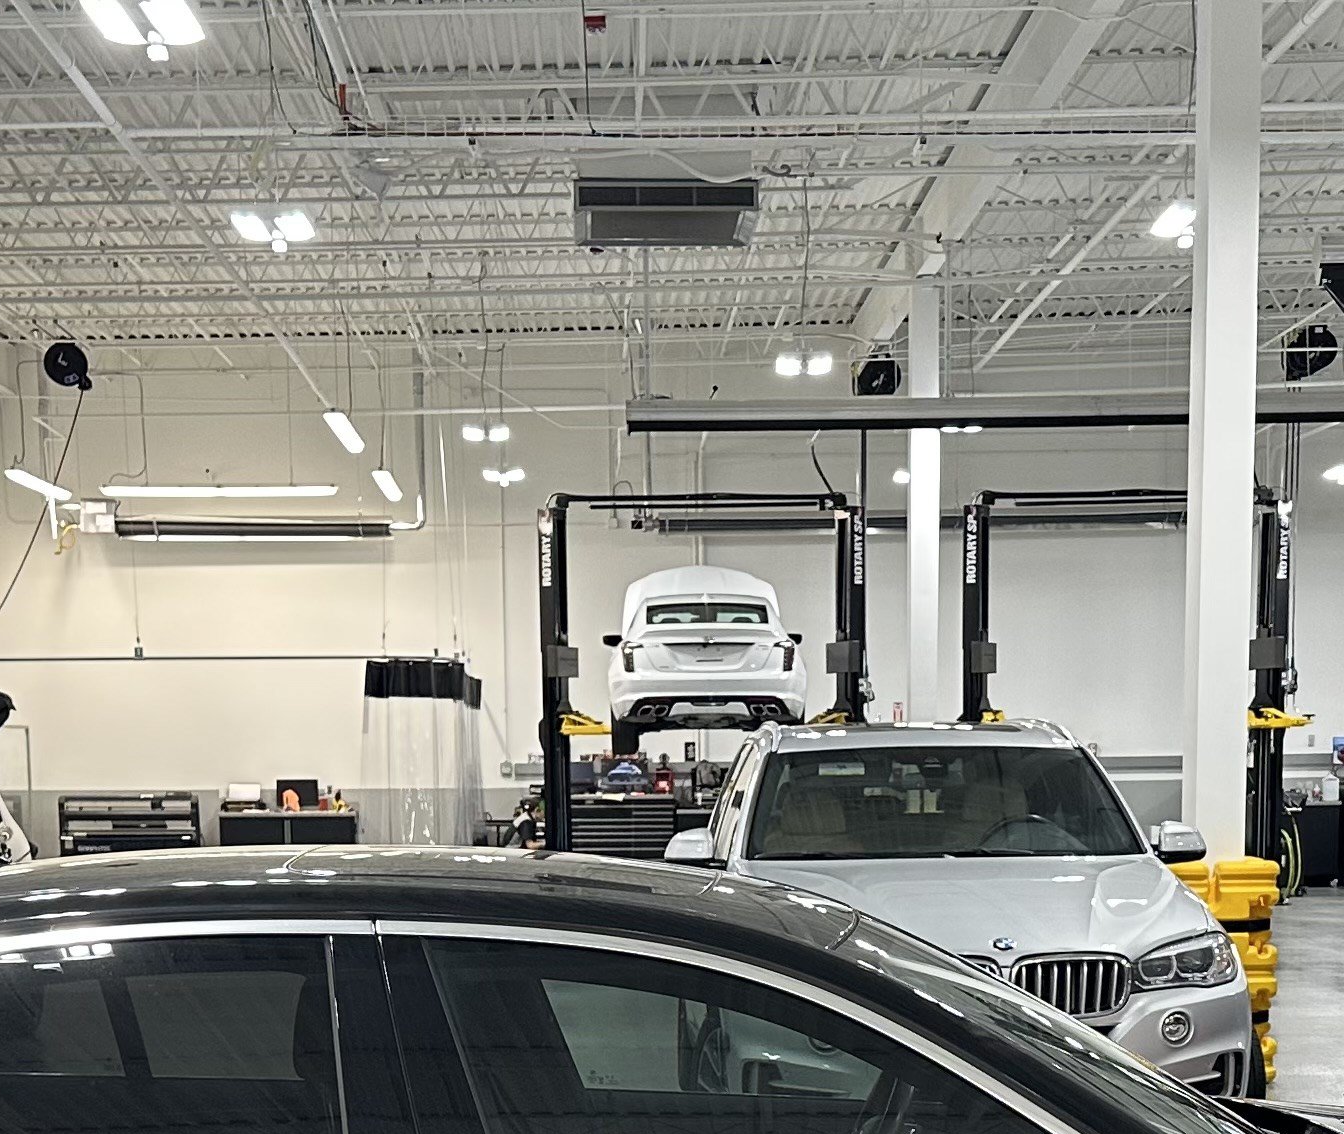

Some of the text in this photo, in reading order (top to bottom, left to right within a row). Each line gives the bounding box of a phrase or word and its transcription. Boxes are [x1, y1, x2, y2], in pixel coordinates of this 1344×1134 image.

[541, 535, 552, 587] ROTARY
[854, 534, 863, 584] ROTARY
[966, 533, 977, 583] ROTARY
